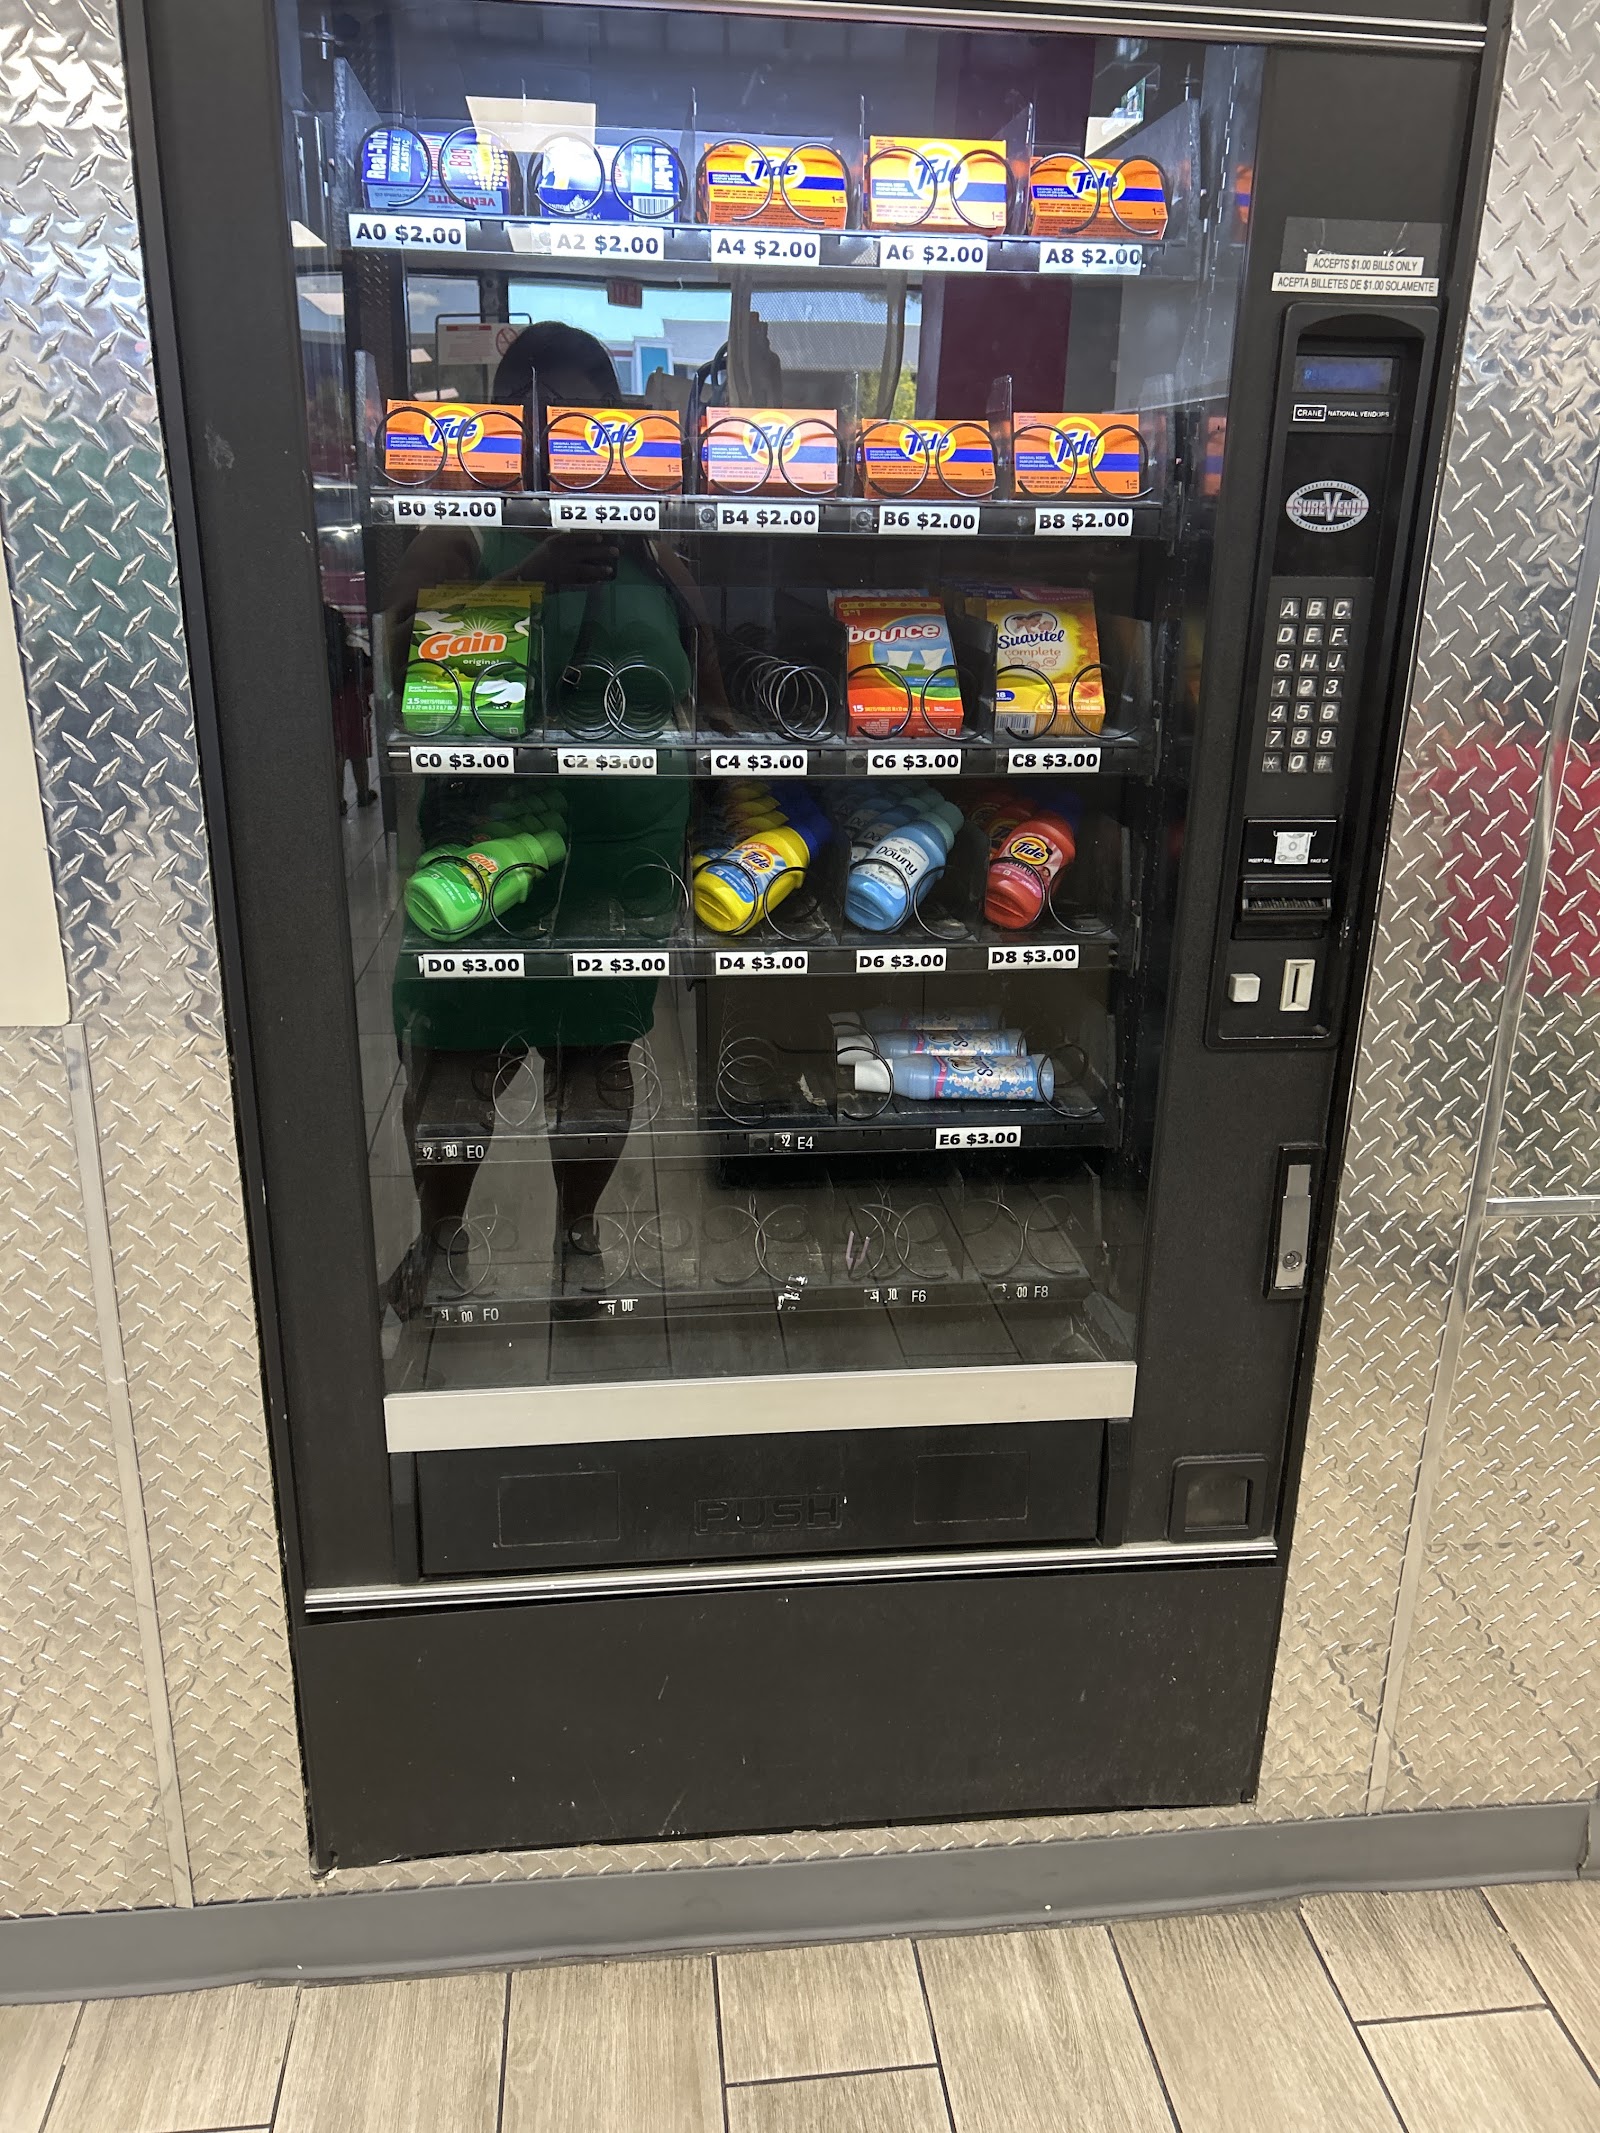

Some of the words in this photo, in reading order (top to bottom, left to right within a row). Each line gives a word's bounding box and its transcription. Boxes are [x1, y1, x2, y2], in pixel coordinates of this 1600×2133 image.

[391, 136, 401, 173] DURABLE
[401, 139, 411, 173] PLASTIC
[449, 148, 473, 167] Bag
[751, 158, 797, 180] Tide
[915, 159, 962, 190] Tide
[1072, 170, 1118, 193] Tide
[355, 223, 388, 241] A0
[394, 224, 462, 246] $2.00
[556, 232, 586, 251] A2
[594, 234, 659, 255] $2.00
[716, 235, 746, 255] A4
[754, 236, 817, 259] $2.00
[886, 244, 914, 261] A6
[922, 245, 984, 264] $2.00
[1045, 248, 1074, 264] A8
[1081, 248, 1142, 268] $2.00
[1313, 257, 1349, 269] ACCEPTS
[1351, 258, 1371, 270] $1.00
[1373, 259, 1394, 271] BILLS
[1396, 260, 1418, 272] ONLY
[1277, 277, 1310, 289] ACEPTA
[1311, 278, 1349, 290] BILLETES
[1350, 279, 1362, 290] DE
[1363, 279, 1385, 291] $1.00
[1385, 280, 1435, 293] SOLAMENTE
[1297, 409, 1322, 417] CRANE
[1328, 410, 1358, 418] NATIONAL
[430, 417, 477, 444] Tide
[591, 423, 637, 449] Tide
[750, 425, 794, 455] Tide
[905, 431, 949, 456] Tide
[1055, 432, 1099, 463] Tide
[399, 501, 427, 517] B0
[434, 500, 497, 520] $2.00
[560, 506, 588, 521] B2
[595, 506, 656, 523] $2.00
[722, 509, 750, 525] B4
[756, 509, 816, 528] $2.00
[883, 511, 910, 527] B6
[916, 511, 976, 531] $2.00
[1039, 513, 1066, 530] B8
[1071, 512, 1130, 532] $2.00
[1281, 602, 1295, 616] A
[1308, 602, 1321, 616] B
[1334, 601, 1348, 617] C
[848, 624, 940, 643] bounce
[998, 629, 1065, 649] Suavitel
[1278, 628, 1292, 643] D
[1305, 628, 1317, 643] E
[1331, 628, 1344, 643] F
[419, 631, 505, 660] Gain
[1004, 647, 1061, 658] complete
[1276, 654, 1290, 669] G
[1301, 654, 1316, 668] H
[1328, 654, 1341, 669] J
[1277, 680, 1286, 694] 1
[1300, 680, 1313, 694] 2
[1326, 680, 1339, 694] 3
[406, 697, 420, 705] 15
[852, 705, 864, 713] 15
[1271, 706, 1283, 719] 4
[1297, 705, 1310, 719] 5
[1322, 705, 1335, 719] 6
[1270, 731, 1281, 744] 7
[1294, 730, 1306, 745] 8
[1320, 730, 1333, 745] 9
[415, 753, 442, 769] C0
[449, 753, 510, 771] $3.00
[562, 754, 589, 769] C2
[595, 754, 654, 771] $3.00
[715, 754, 741, 769] C4
[747, 754, 804, 772] $3.00
[872, 754, 897, 769] C6
[903, 754, 959, 771] $3.00
[1012, 753, 1037, 768] C8
[1042, 753, 1098, 770] $3.00
[1291, 756, 1304, 770] 0
[1012, 841, 1046, 859] Tide
[466, 852, 499, 873] Gain
[742, 851, 770, 869] Tide
[876, 845, 918, 876] Downy
[577, 958, 603, 972] D2
[610, 958, 666, 974] $3.00
[719, 957, 746, 970] D4
[751, 956, 806, 972] $3.00
[859, 955, 885, 968] D6
[890, 954, 944, 970] $3.00
[991, 950, 1017, 964] D8
[1023, 948, 1076, 966] $3.00
[428, 958, 456, 973] D0
[462, 958, 520, 975] $3.00
[797, 1136, 814, 1150] E4
[939, 1133, 961, 1146] E6
[966, 1131, 1018, 1147] $3.00
[466, 1144, 485, 1159] E0
[911, 1290, 927, 1303] F6
[1034, 1285, 1049, 1299] F8
[483, 1307, 499, 1321] F0
[699, 1497, 838, 1532] PUSH
